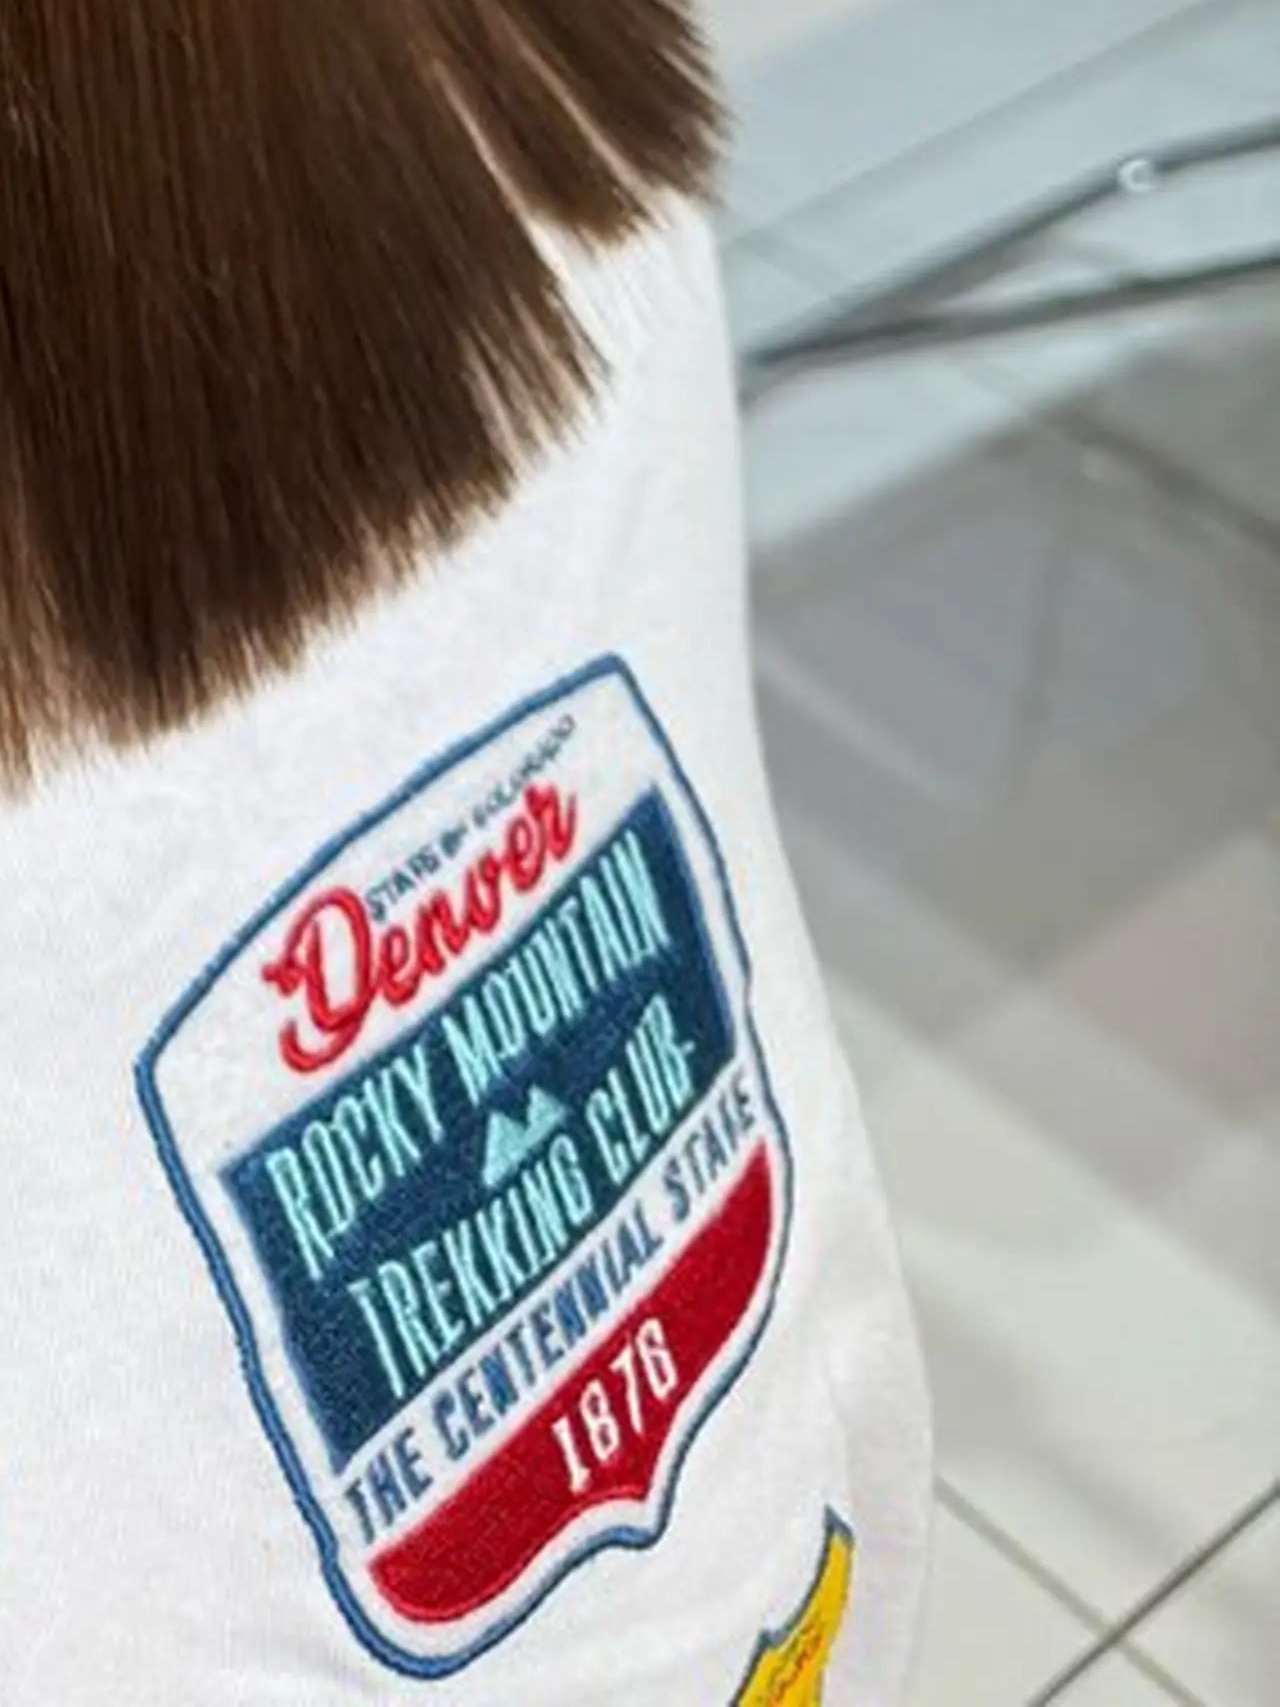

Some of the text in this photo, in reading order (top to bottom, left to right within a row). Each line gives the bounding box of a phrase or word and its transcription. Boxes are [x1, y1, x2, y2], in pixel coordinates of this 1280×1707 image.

[262, 778, 578, 1073] Denver
[265, 828, 672, 1282] ROCKY MOUNTAIN
[345, 1073, 754, 1543] THE CENTENNIAL STATE
[347, 992, 693, 1399] TREKKING CLUB
[552, 1318, 679, 1494] 1876
